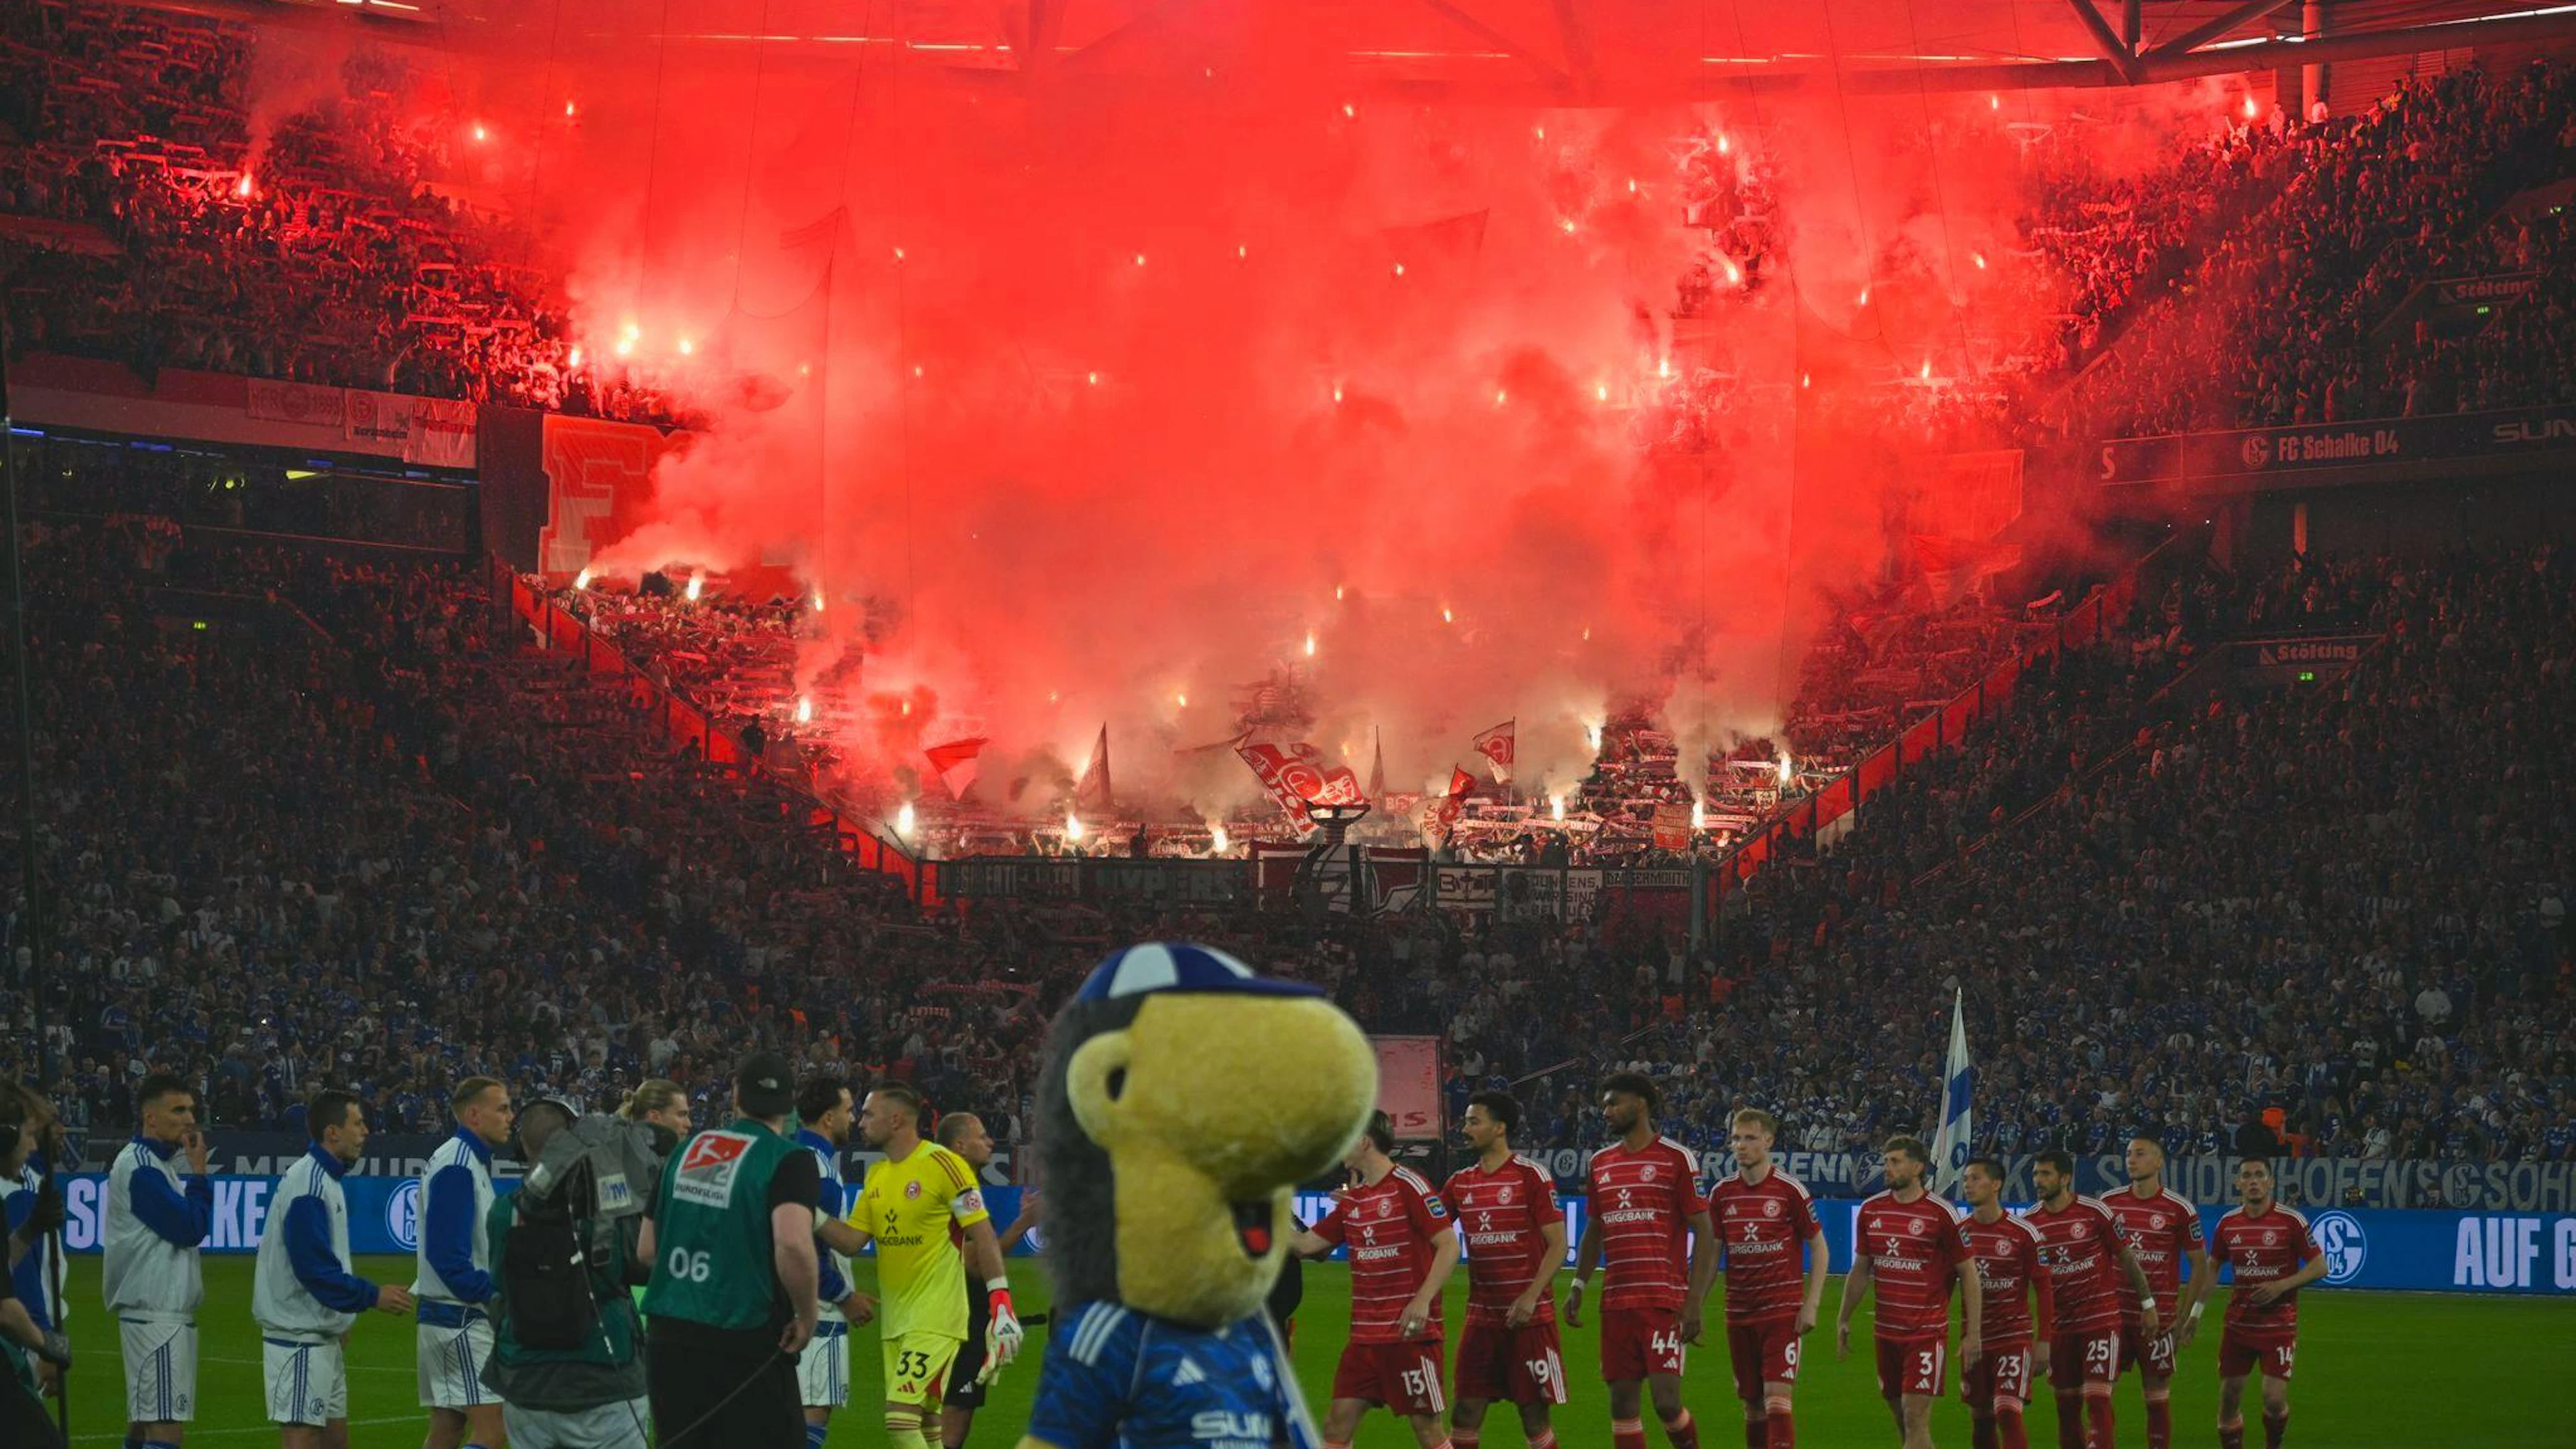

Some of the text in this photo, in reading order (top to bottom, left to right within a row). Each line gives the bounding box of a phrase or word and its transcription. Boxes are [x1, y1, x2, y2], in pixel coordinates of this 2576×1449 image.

[2279, 430, 2400, 462] FC Schalke 04
[2277, 643, 2359, 662] Stölting
[668, 1246, 711, 1283] 06
[2453, 1216, 2541, 1287] AUF
[1651, 1330, 1680, 1356] 44
[1784, 1342, 1796, 1366] 6
[2086, 1339, 2110, 1362] 25
[2275, 1345, 2294, 1366] 14
[896, 1350, 930, 1379] 33
[1525, 1358, 1550, 1384] 19
[1919, 1351, 1933, 1376] 3
[1996, 1354, 2022, 1377] 23
[1401, 1369, 1427, 1397] 13
